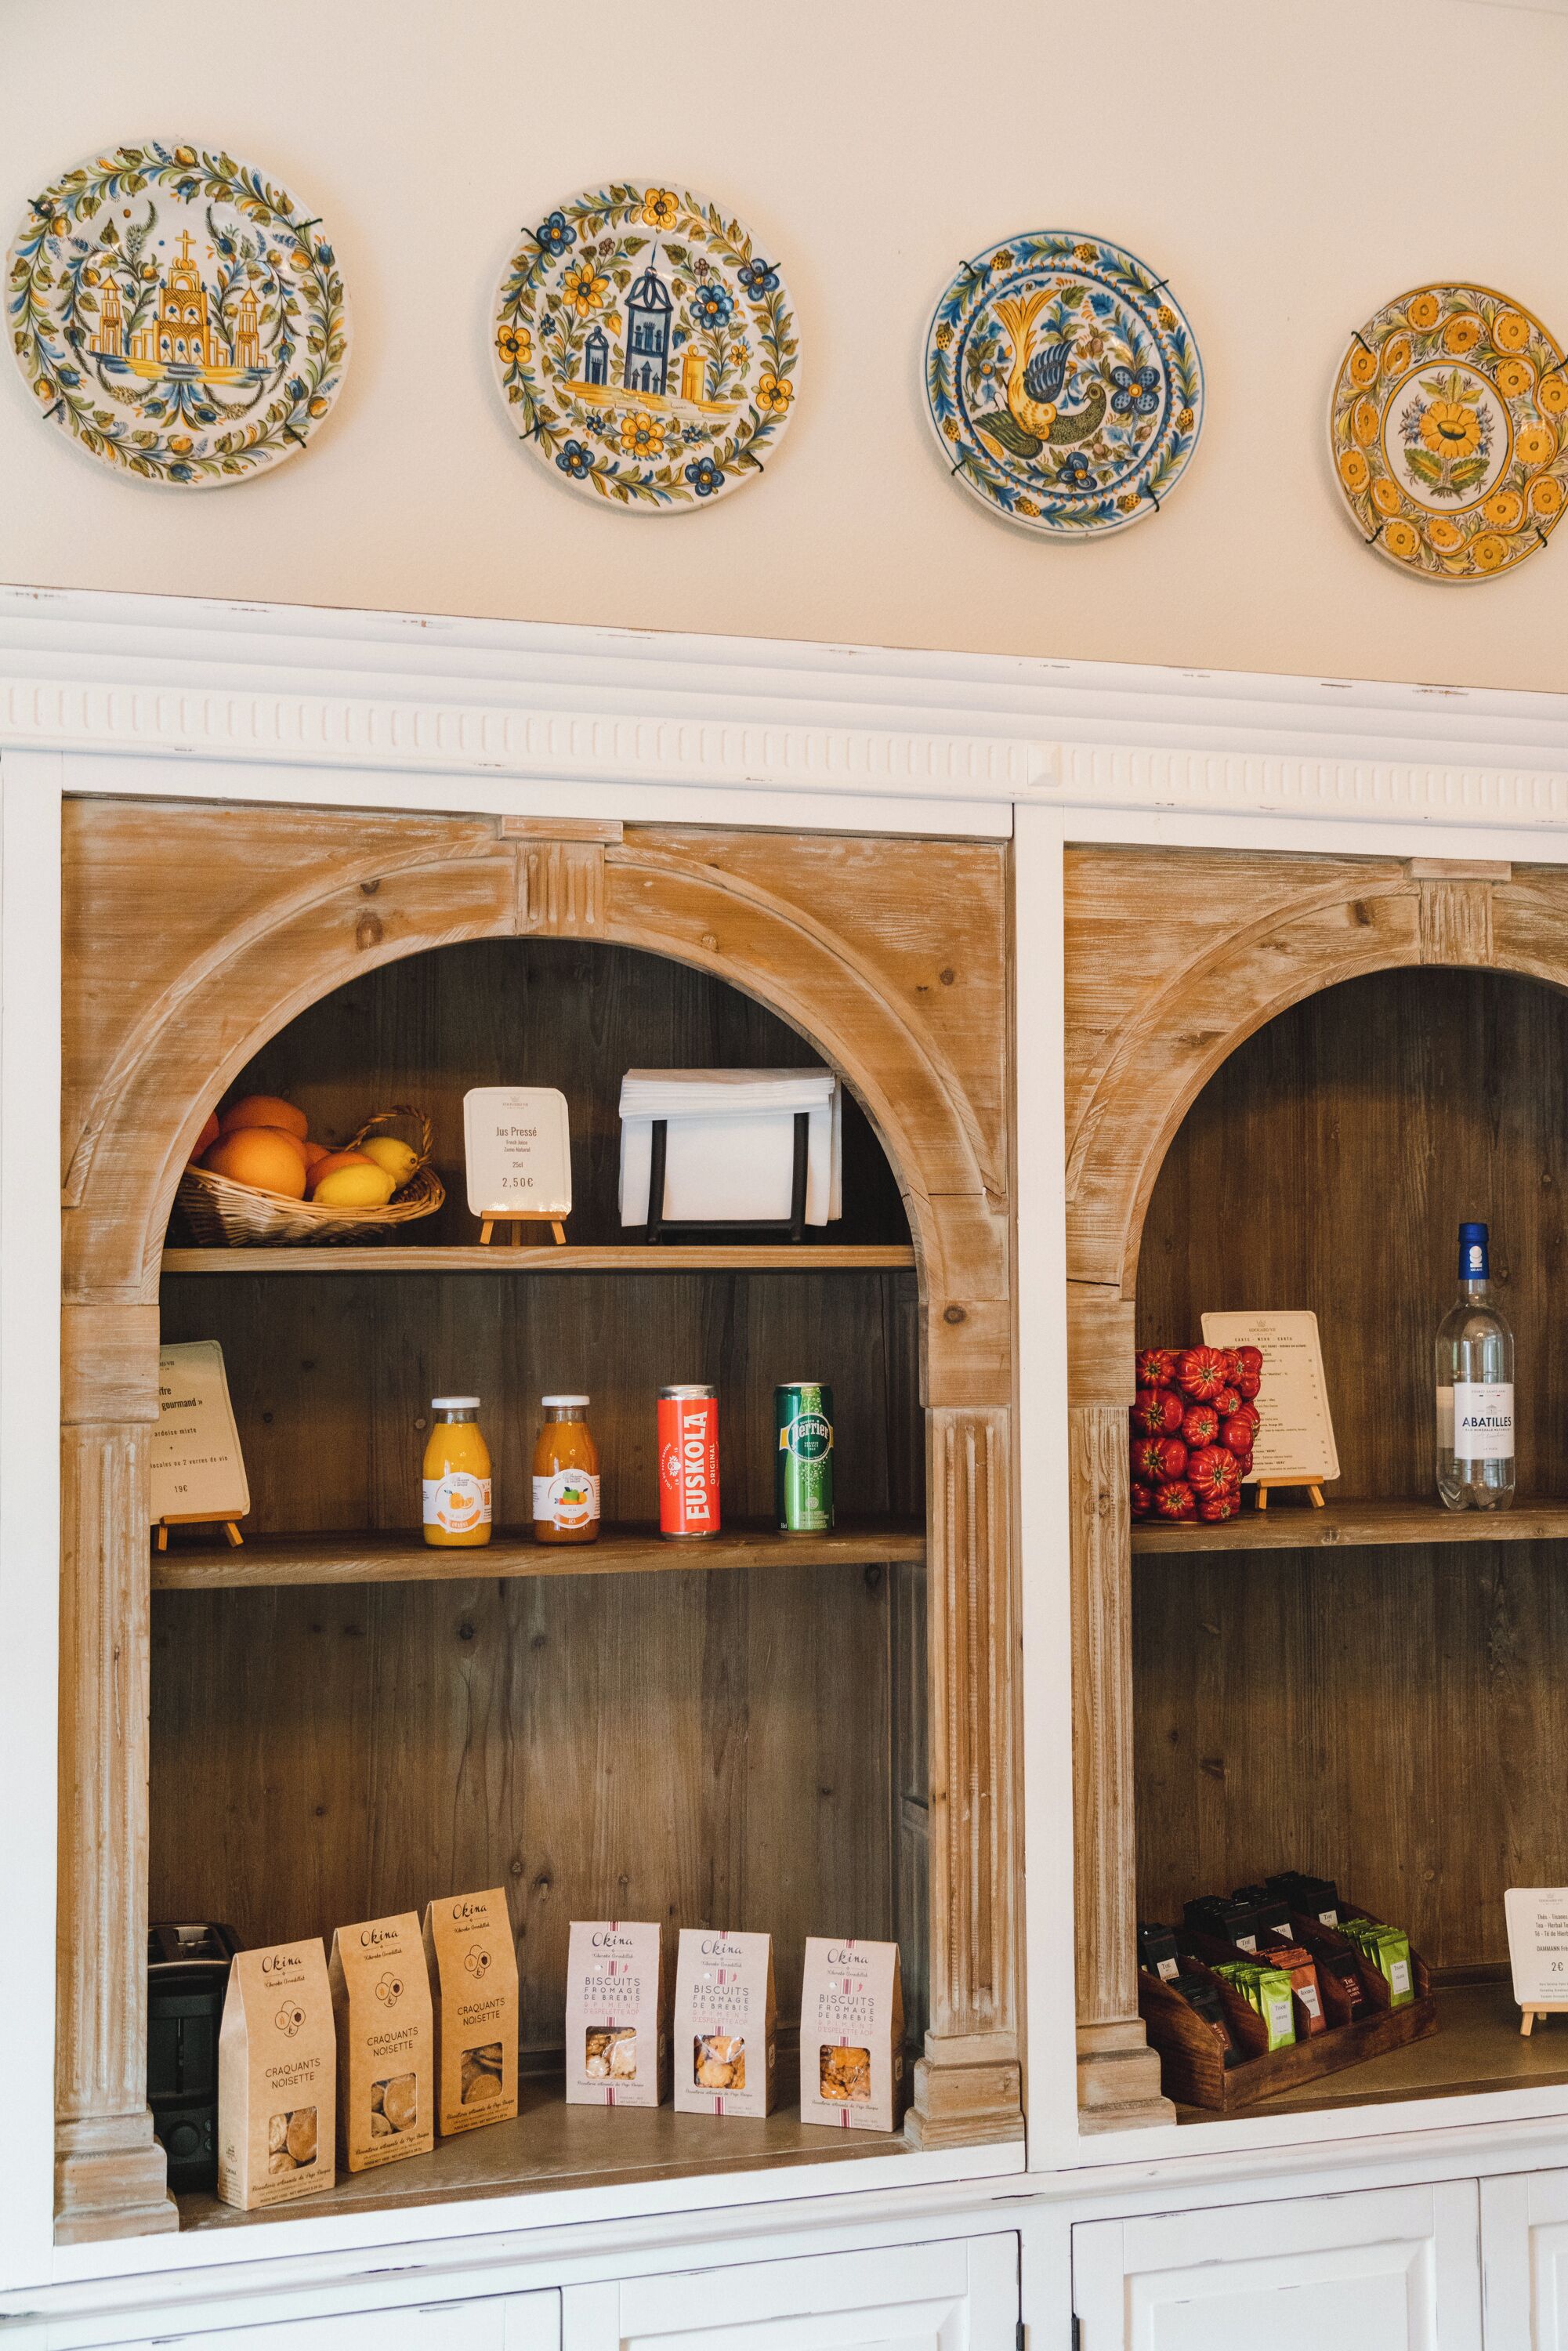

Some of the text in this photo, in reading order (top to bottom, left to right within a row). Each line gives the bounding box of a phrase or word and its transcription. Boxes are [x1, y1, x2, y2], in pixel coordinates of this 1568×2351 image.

[496, 1126, 538, 1136] Jus Pressé
[502, 1177, 534, 1188] 2,50€
[161, 1397, 197, 1411] gourmand
[1462, 1416, 1512, 1427] ABATILLES
[683, 1411, 711, 1520] EUSKOLA
[174, 1484, 188, 1493] 19€
[453, 1902, 488, 1919] Okina
[360, 1929, 400, 1947] Okina
[592, 1932, 633, 1947] Okina
[701, 1939, 743, 1955] Okina
[262, 1954, 302, 1973] Okina
[827, 1948, 869, 1965] Okina
[585, 1976, 640, 1987] BISCUITS
[693, 1984, 749, 1996] BISCUITS
[693, 1994, 748, 2004] FROMAGE
[819, 1994, 875, 2007] BISCUITS
[458, 1998, 505, 2016] CRAQUANTS
[711, 2003, 748, 2012] BREBIS
[818, 2004, 874, 2015] FROMAGE
[463, 2010, 500, 2026] NOISETTE
[836, 2013, 874, 2023] BREBIS
[367, 2027, 418, 2046] CRAQUANTS
[373, 2039, 413, 2057] NOISETTE
[265, 2057, 320, 2078] CRAQUANTS
[271, 2071, 315, 2090] NOISETTE
